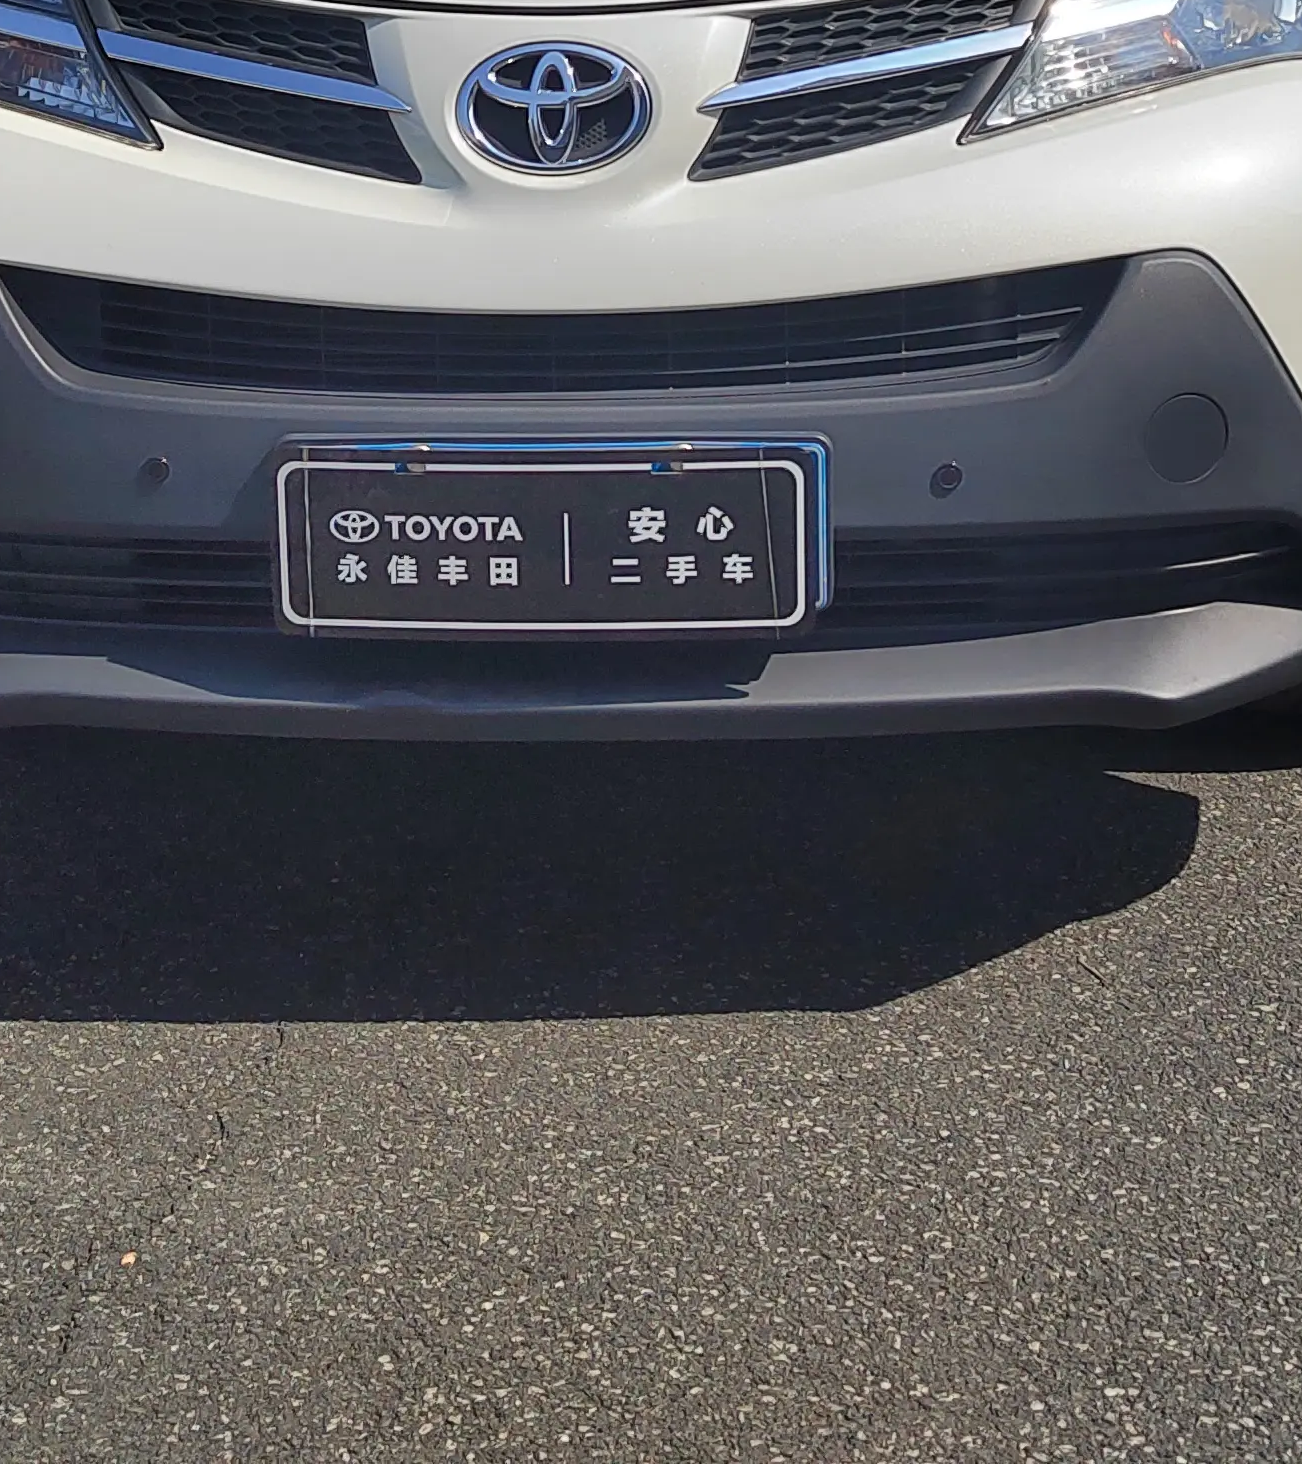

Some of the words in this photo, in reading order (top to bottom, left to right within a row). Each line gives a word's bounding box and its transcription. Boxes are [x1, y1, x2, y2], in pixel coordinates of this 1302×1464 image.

[384, 514, 523, 542] TOYOTA
[627, 506, 735, 544] 安心
[337, 553, 519, 586] 永佳丰田
[610, 552, 755, 585] 二手车
